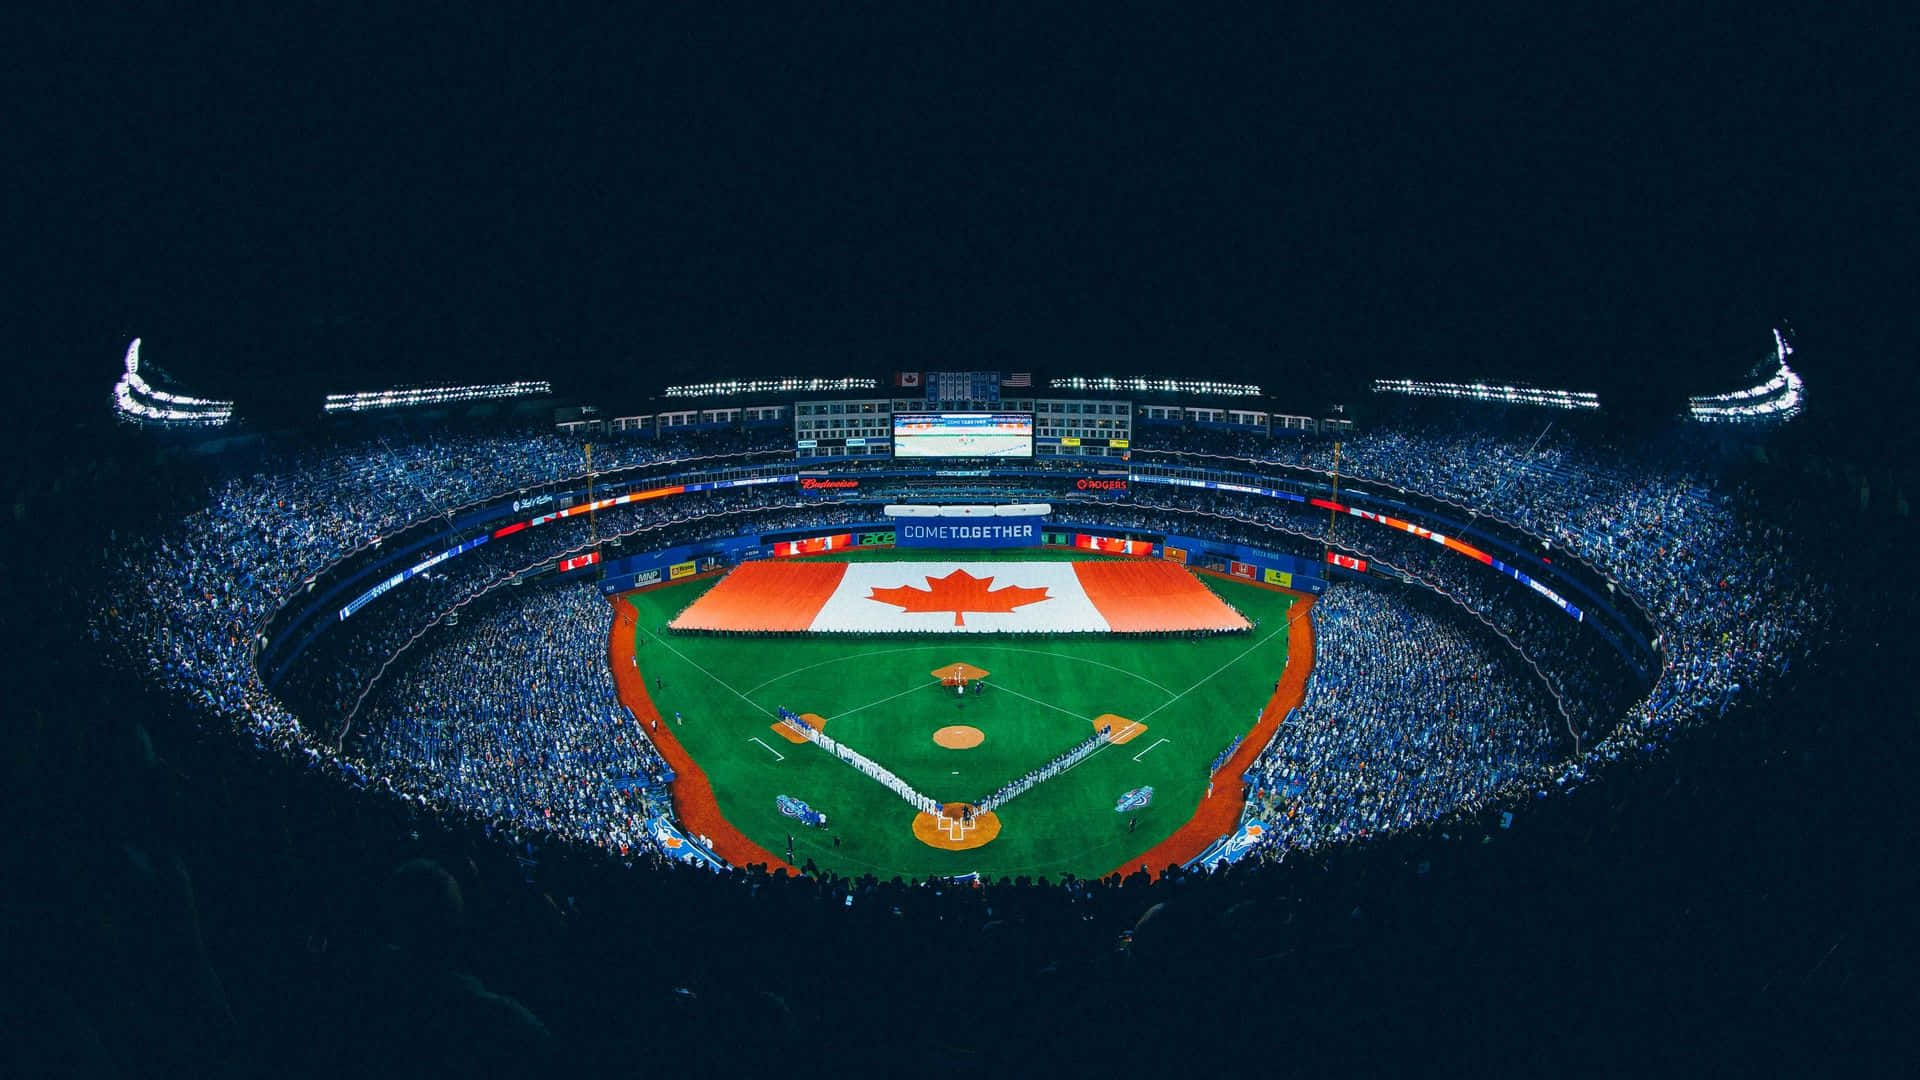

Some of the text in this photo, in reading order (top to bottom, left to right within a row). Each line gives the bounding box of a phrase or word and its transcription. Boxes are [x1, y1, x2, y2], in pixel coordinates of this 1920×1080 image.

[800, 478, 859, 490] Budweiser
[1088, 480, 1127, 490] ROGERS
[862, 532, 896, 545] ace
[904, 525, 949, 539] COME
[638, 570, 658, 583] MNP
